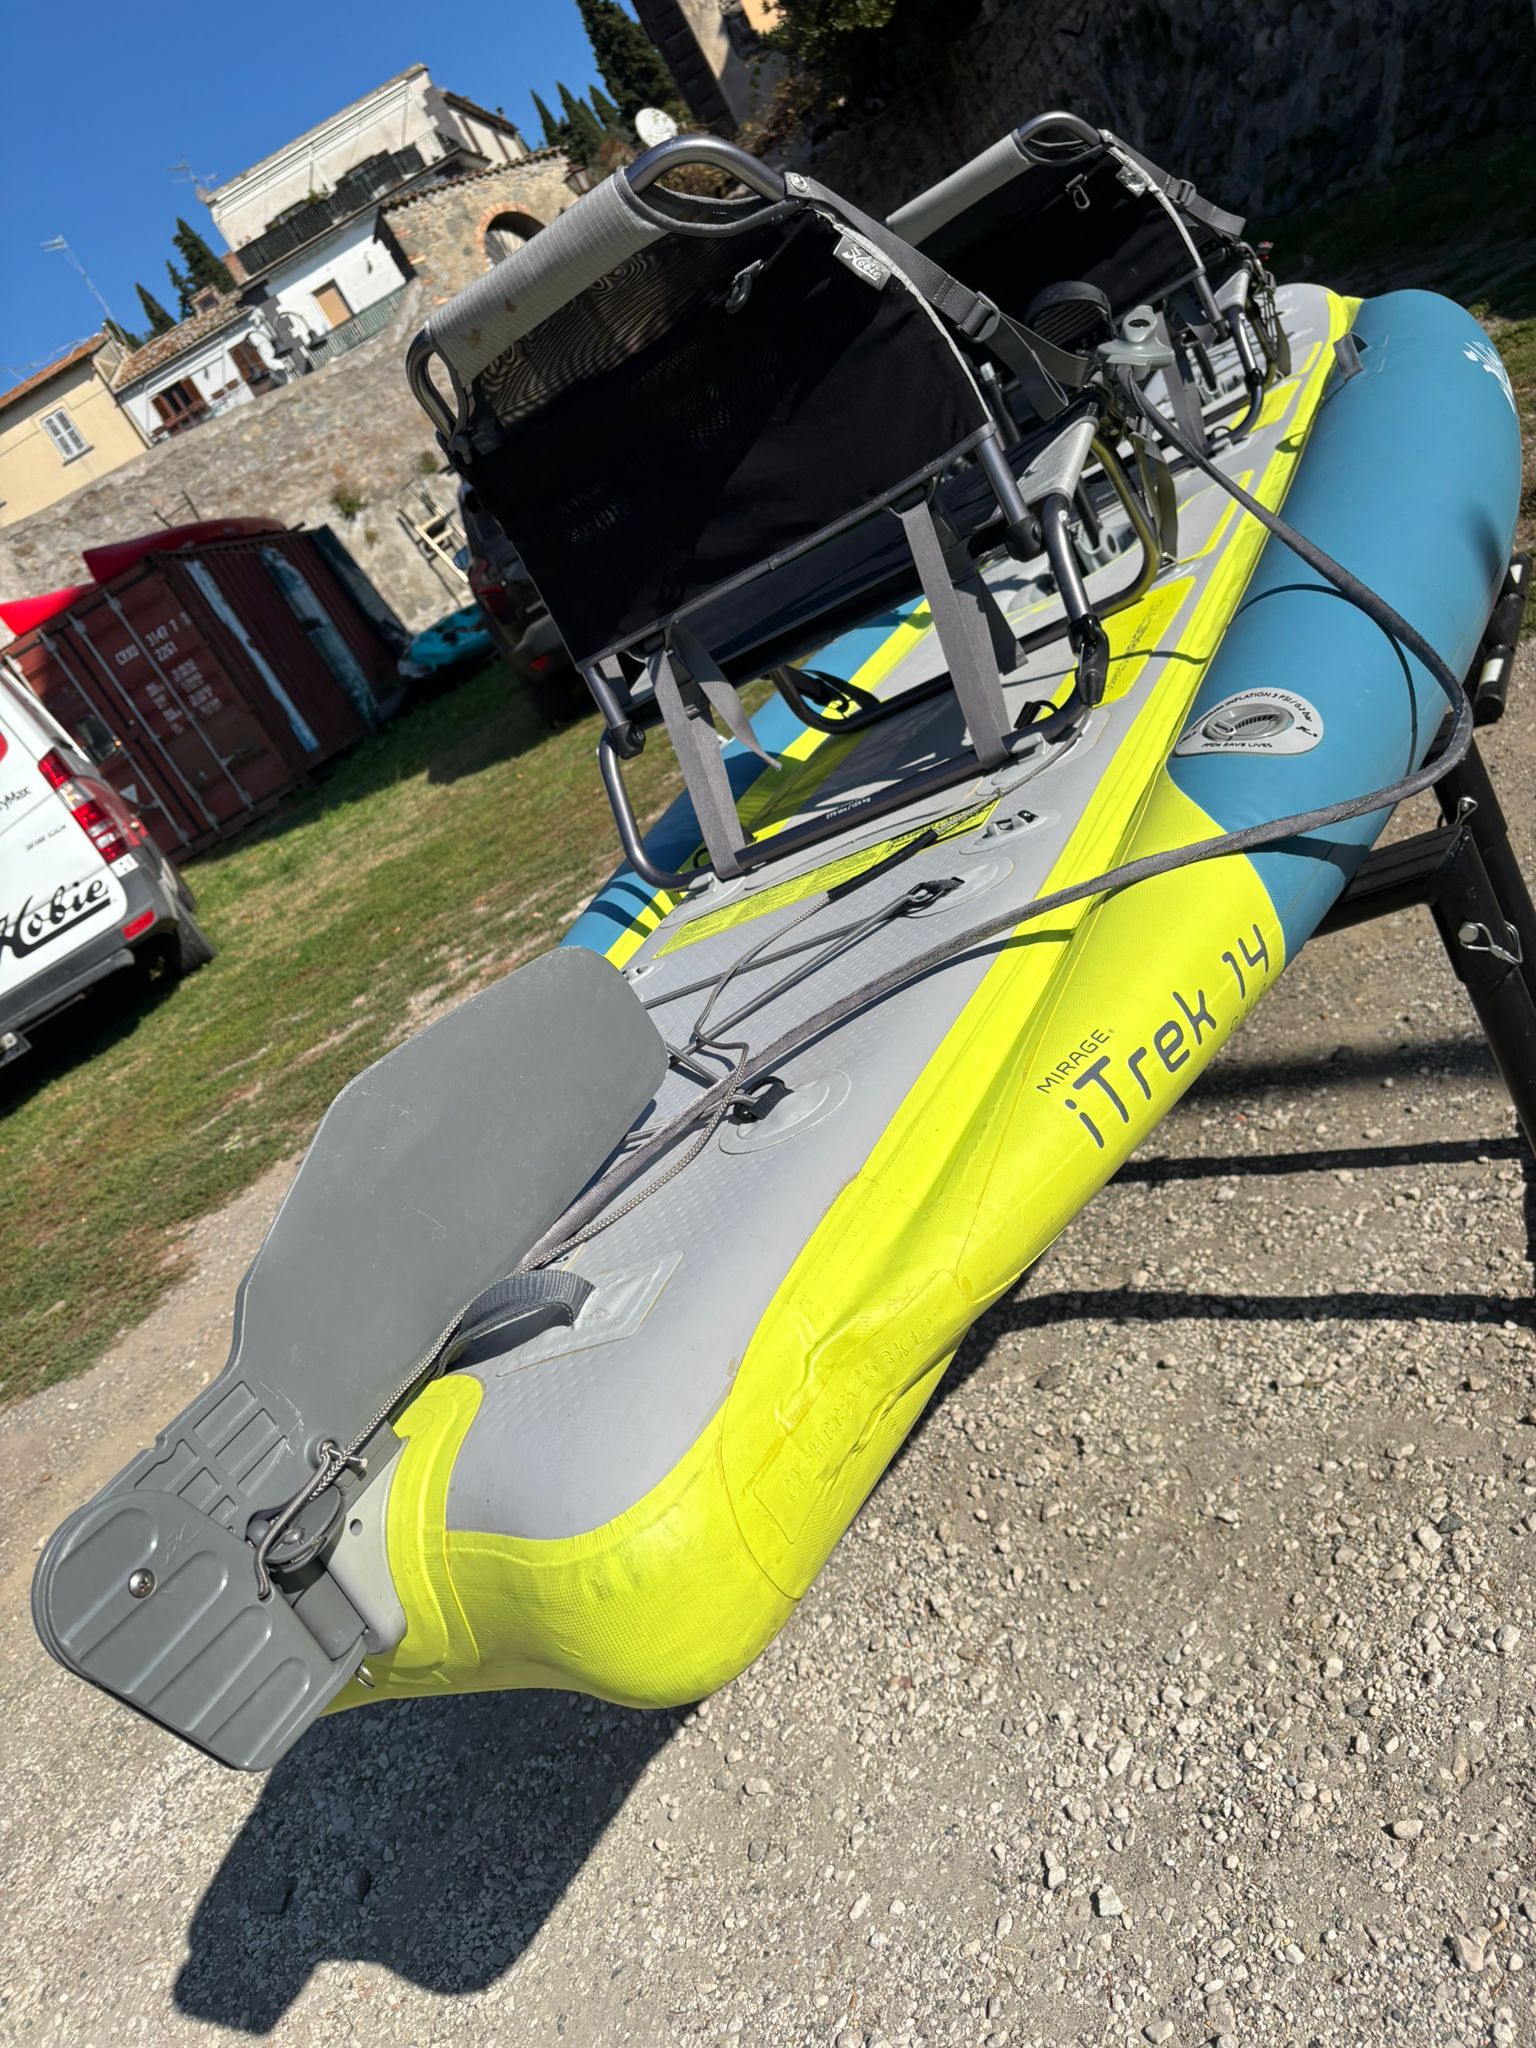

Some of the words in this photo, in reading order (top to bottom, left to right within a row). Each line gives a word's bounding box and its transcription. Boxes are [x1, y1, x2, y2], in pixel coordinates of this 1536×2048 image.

[841, 246, 881, 281] Hobie
[1225, 691, 1271, 706] INFLATION
[1064, 989, 1217, 1149] iTrek
[1221, 923, 1270, 1000] 14
